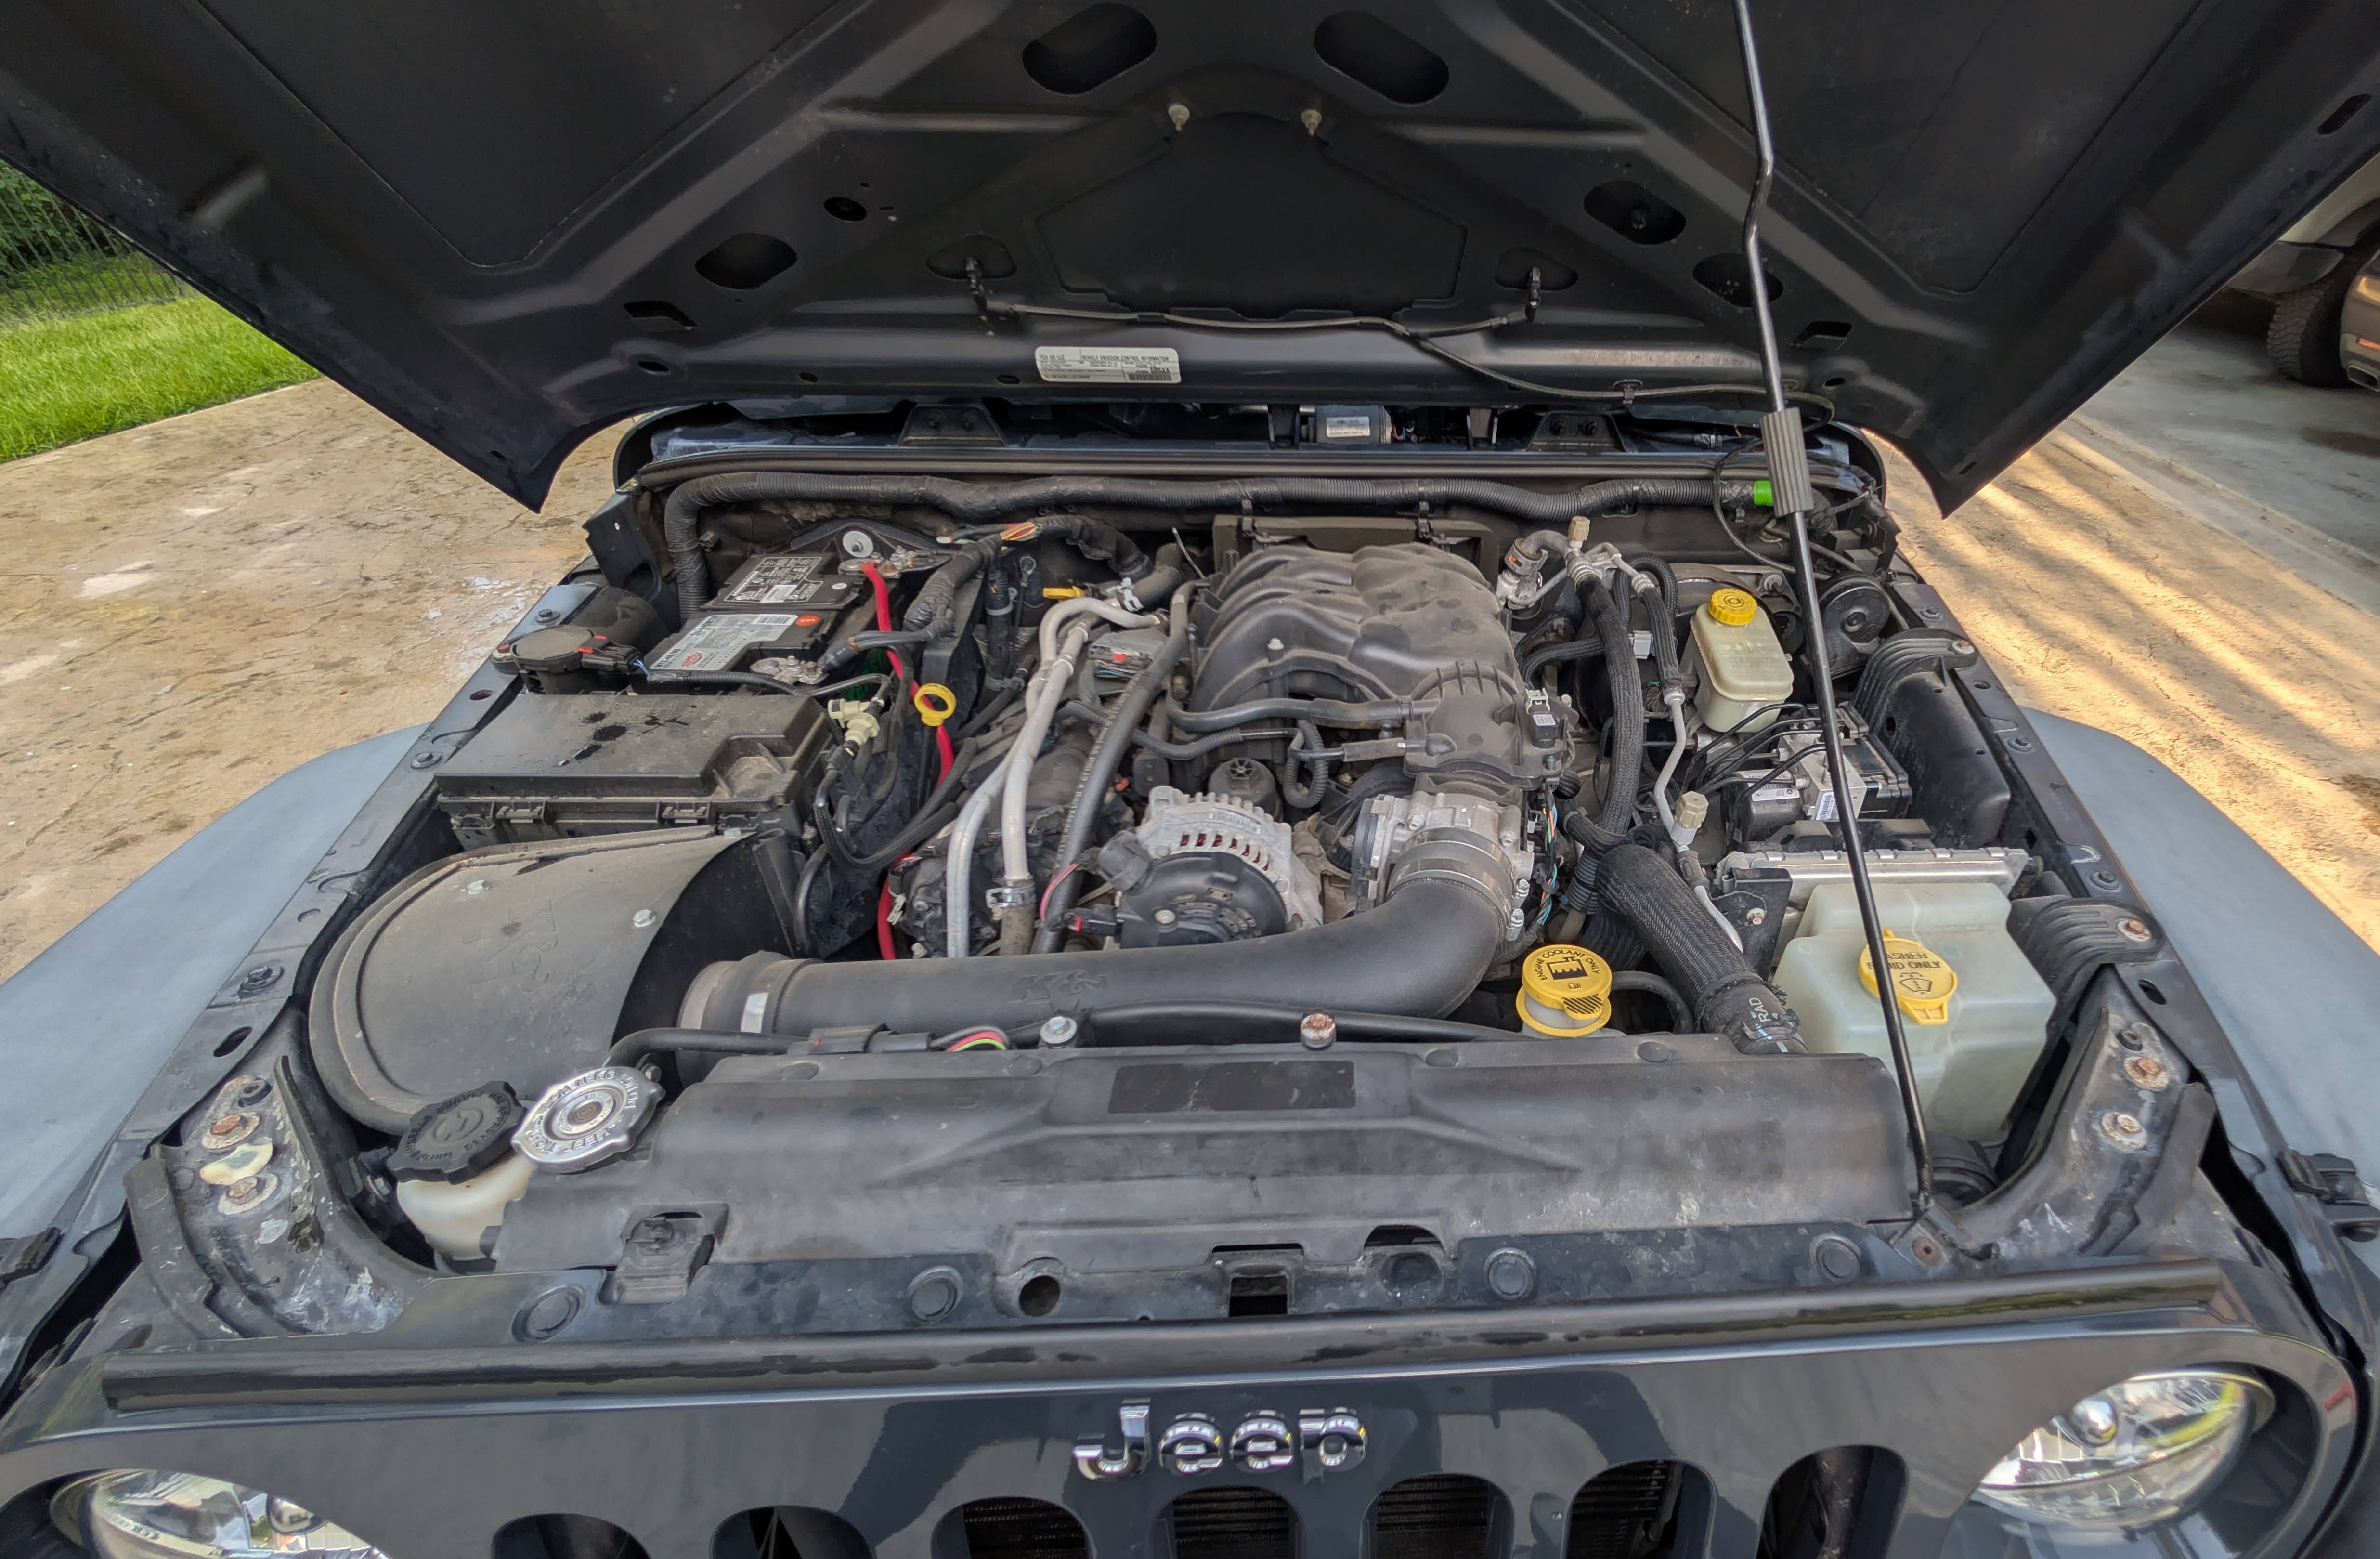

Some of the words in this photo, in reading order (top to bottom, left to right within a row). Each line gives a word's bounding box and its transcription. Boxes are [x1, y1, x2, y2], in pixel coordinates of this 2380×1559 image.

[1534, 958, 1548, 981] ENGINE
[1542, 949, 1586, 959] COOLANT
[1586, 957, 1600, 974] ONLY
[1908, 961, 1941, 969] ONLY
[1748, 997, 1771, 1022] RAD
[563, 1127, 610, 1153] KEEP
[1073, 1399, 1367, 1484] Jeep
